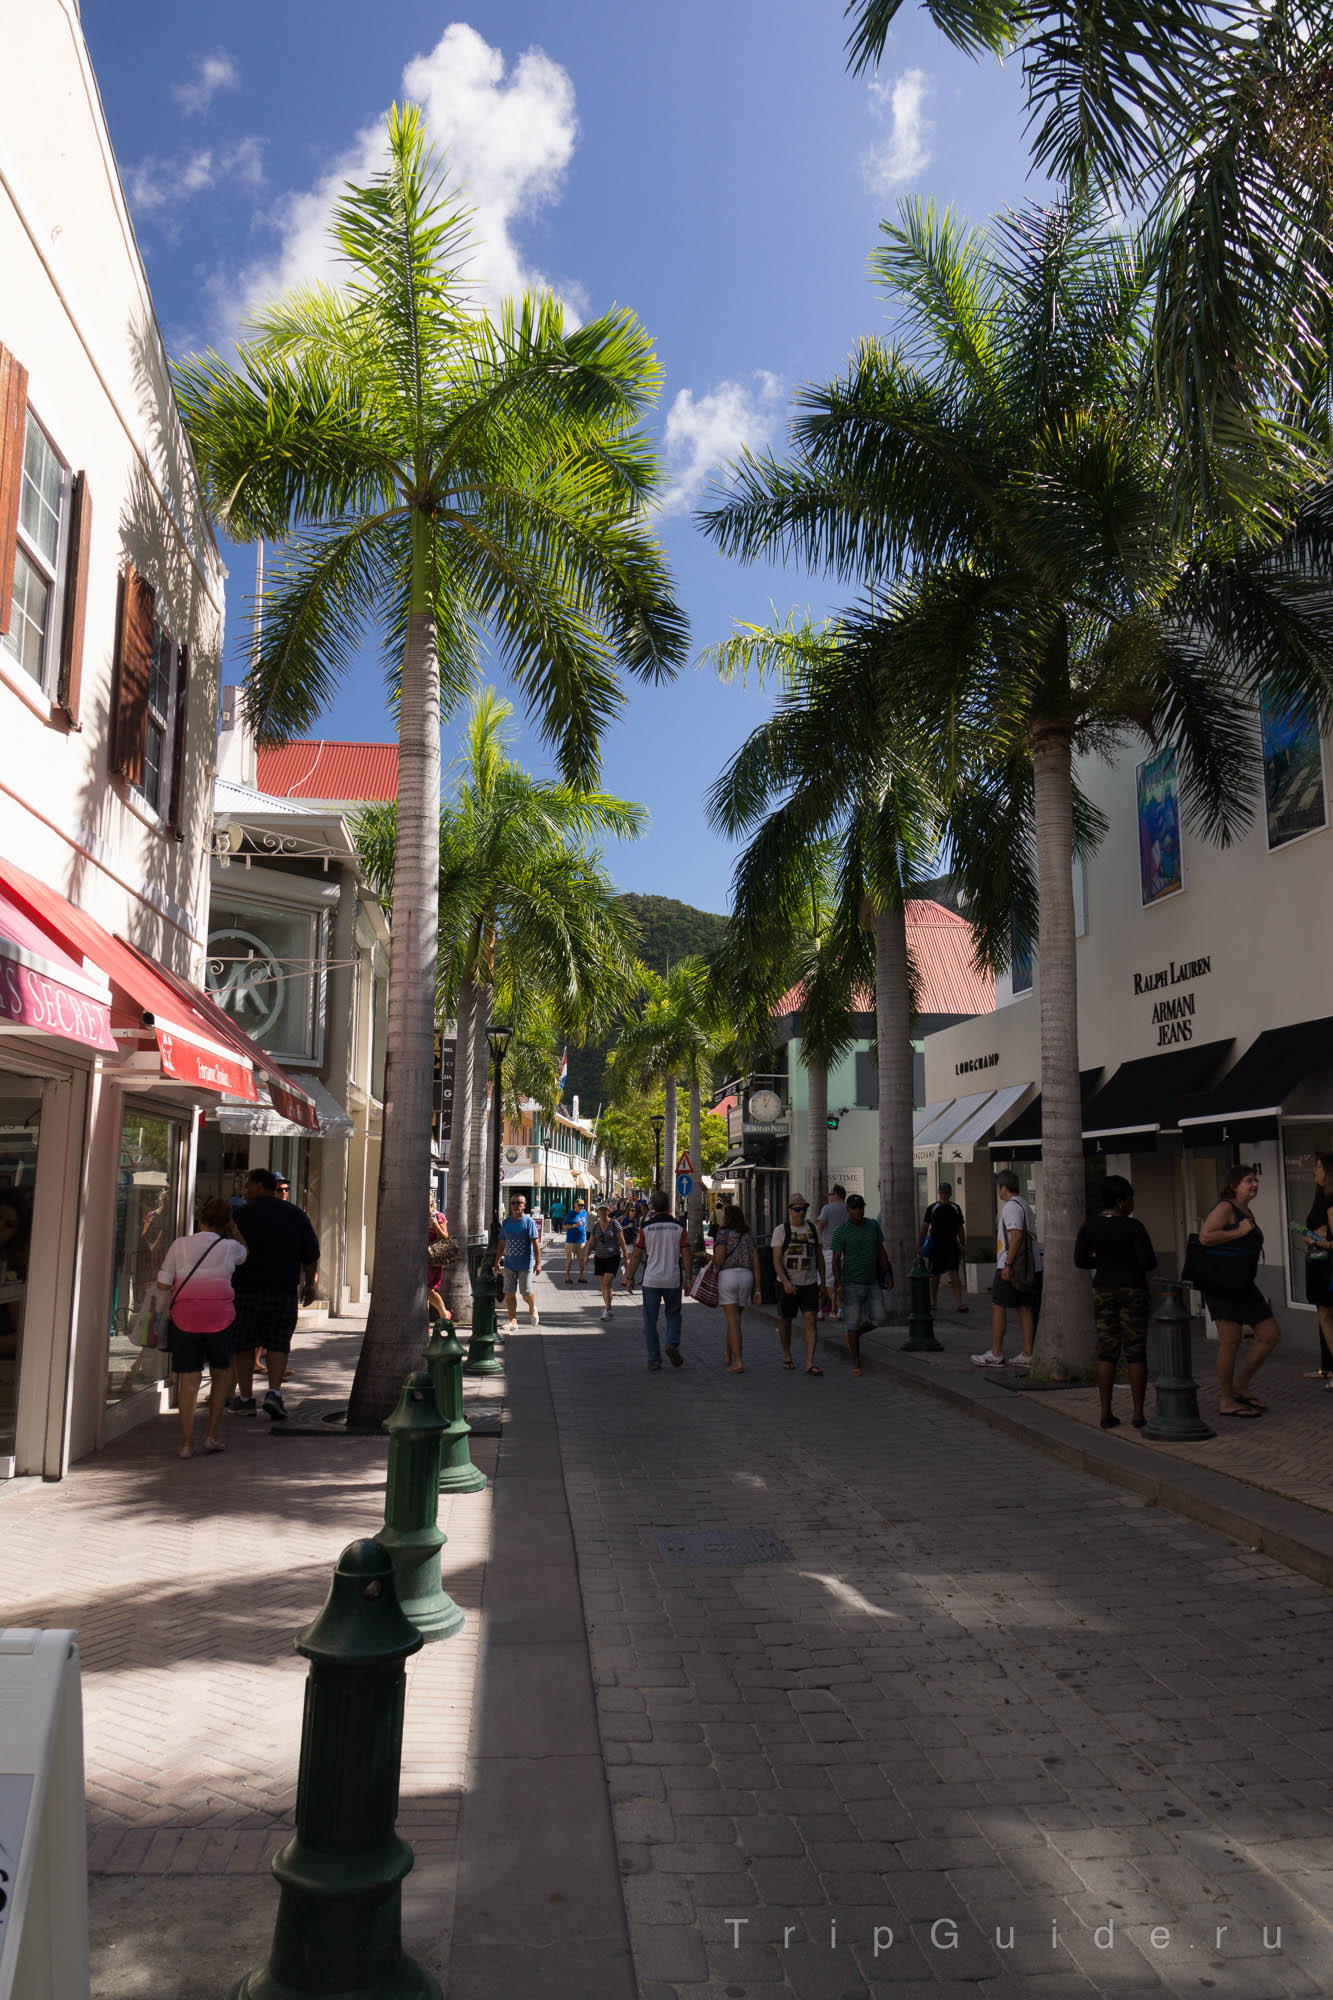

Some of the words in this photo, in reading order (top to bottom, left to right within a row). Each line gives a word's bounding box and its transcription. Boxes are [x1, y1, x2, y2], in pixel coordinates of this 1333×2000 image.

[1133, 970, 1168, 996] RALPH
[1169, 955, 1210, 984] LAUREN
[27, 971, 104, 1045] SECRET
[1151, 993, 1195, 1024] ARMANI
[1157, 1019, 1192, 1047] JEANS
[955, 1053, 999, 1075] LONGCHAMP
